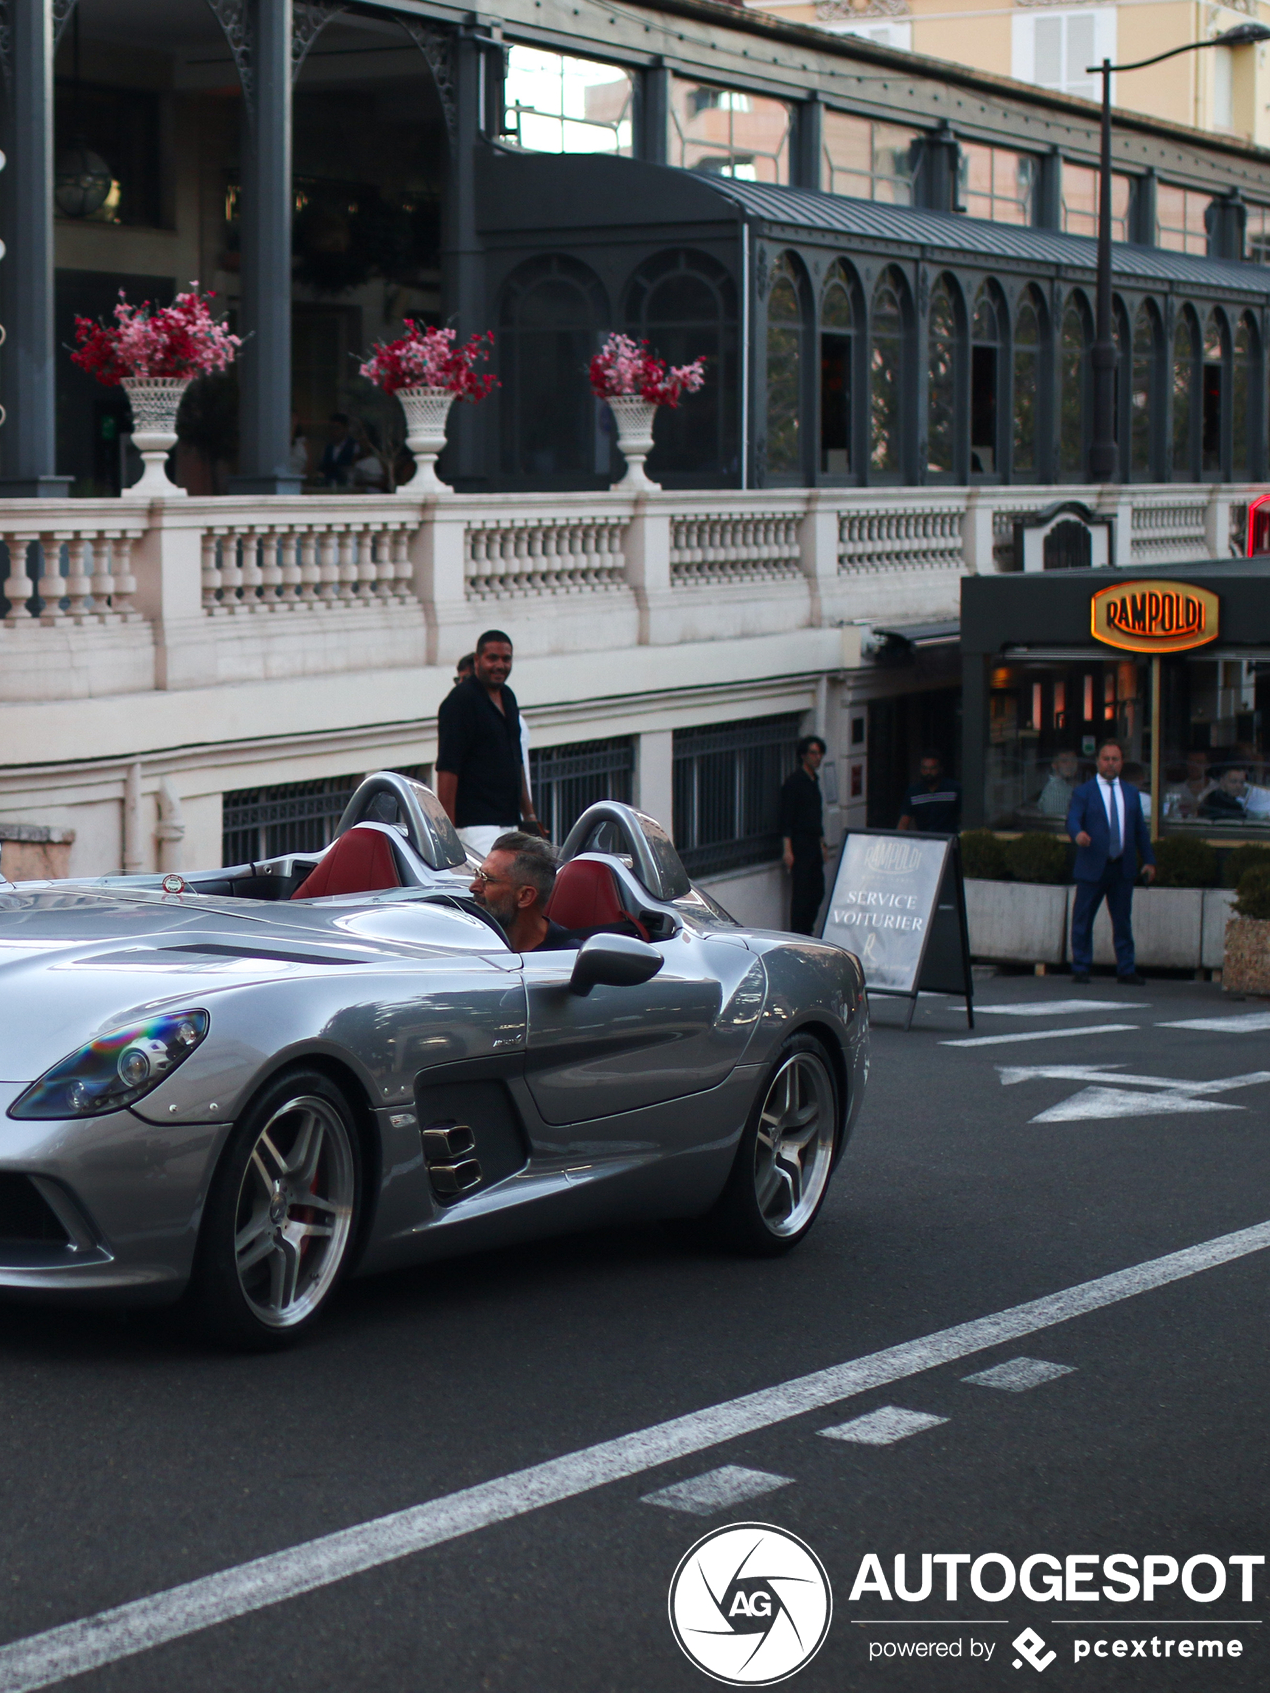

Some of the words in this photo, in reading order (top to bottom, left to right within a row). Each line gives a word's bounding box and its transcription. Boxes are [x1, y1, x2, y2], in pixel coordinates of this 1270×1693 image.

[1107, 590, 1205, 639] RAMPOLDI
[863, 841, 923, 875] RAMPOLDI
[846, 890, 918, 911] SERVICE
[832, 909, 923, 932] VOITURIER
